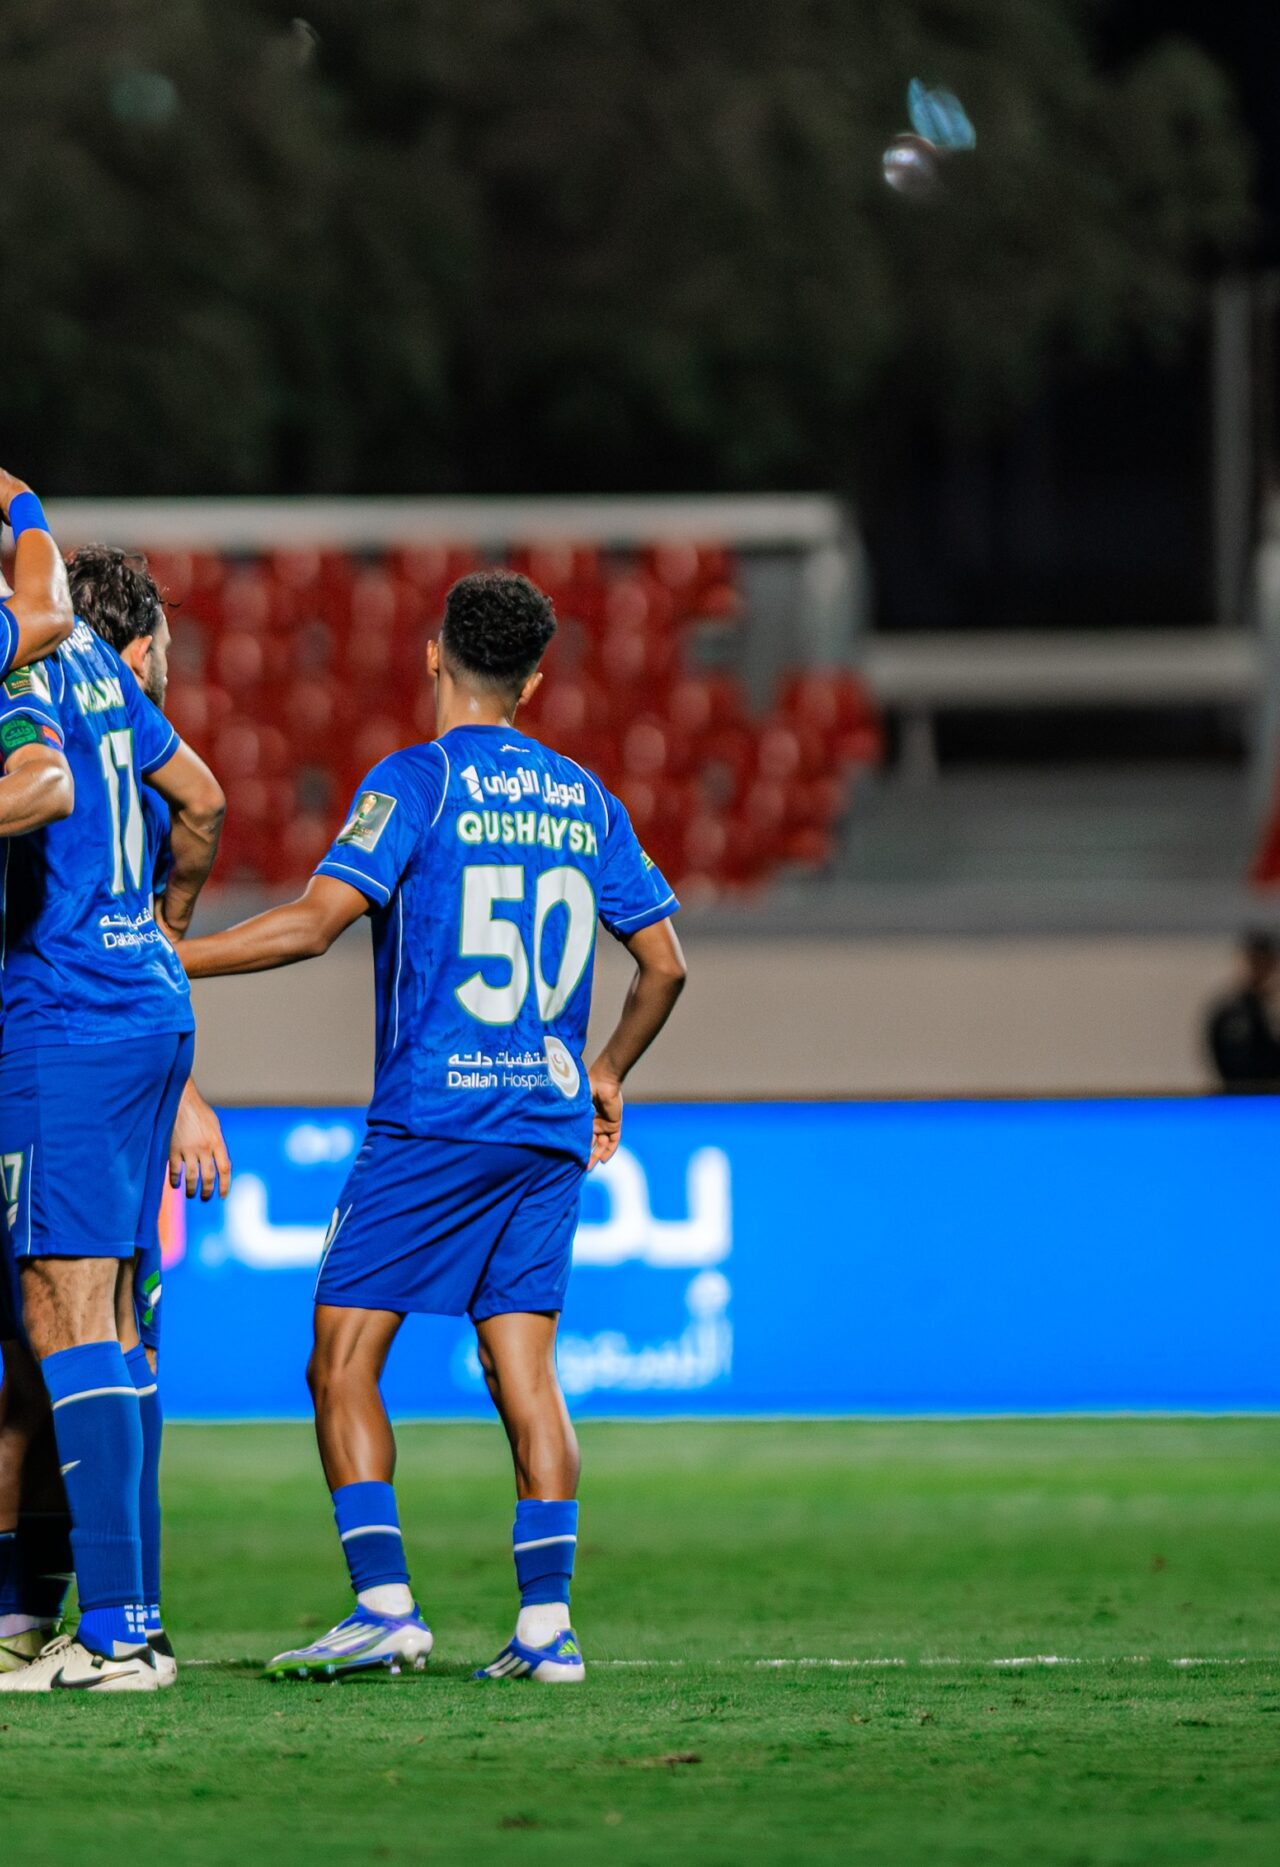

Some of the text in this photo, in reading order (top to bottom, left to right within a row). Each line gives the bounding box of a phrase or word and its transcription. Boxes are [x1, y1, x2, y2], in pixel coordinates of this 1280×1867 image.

[97, 727, 144, 896] 17
[483, 767, 586, 808] تمويل الأولى
[454, 864, 598, 1025] 50
[447, 1071, 498, 1089] Dallah
